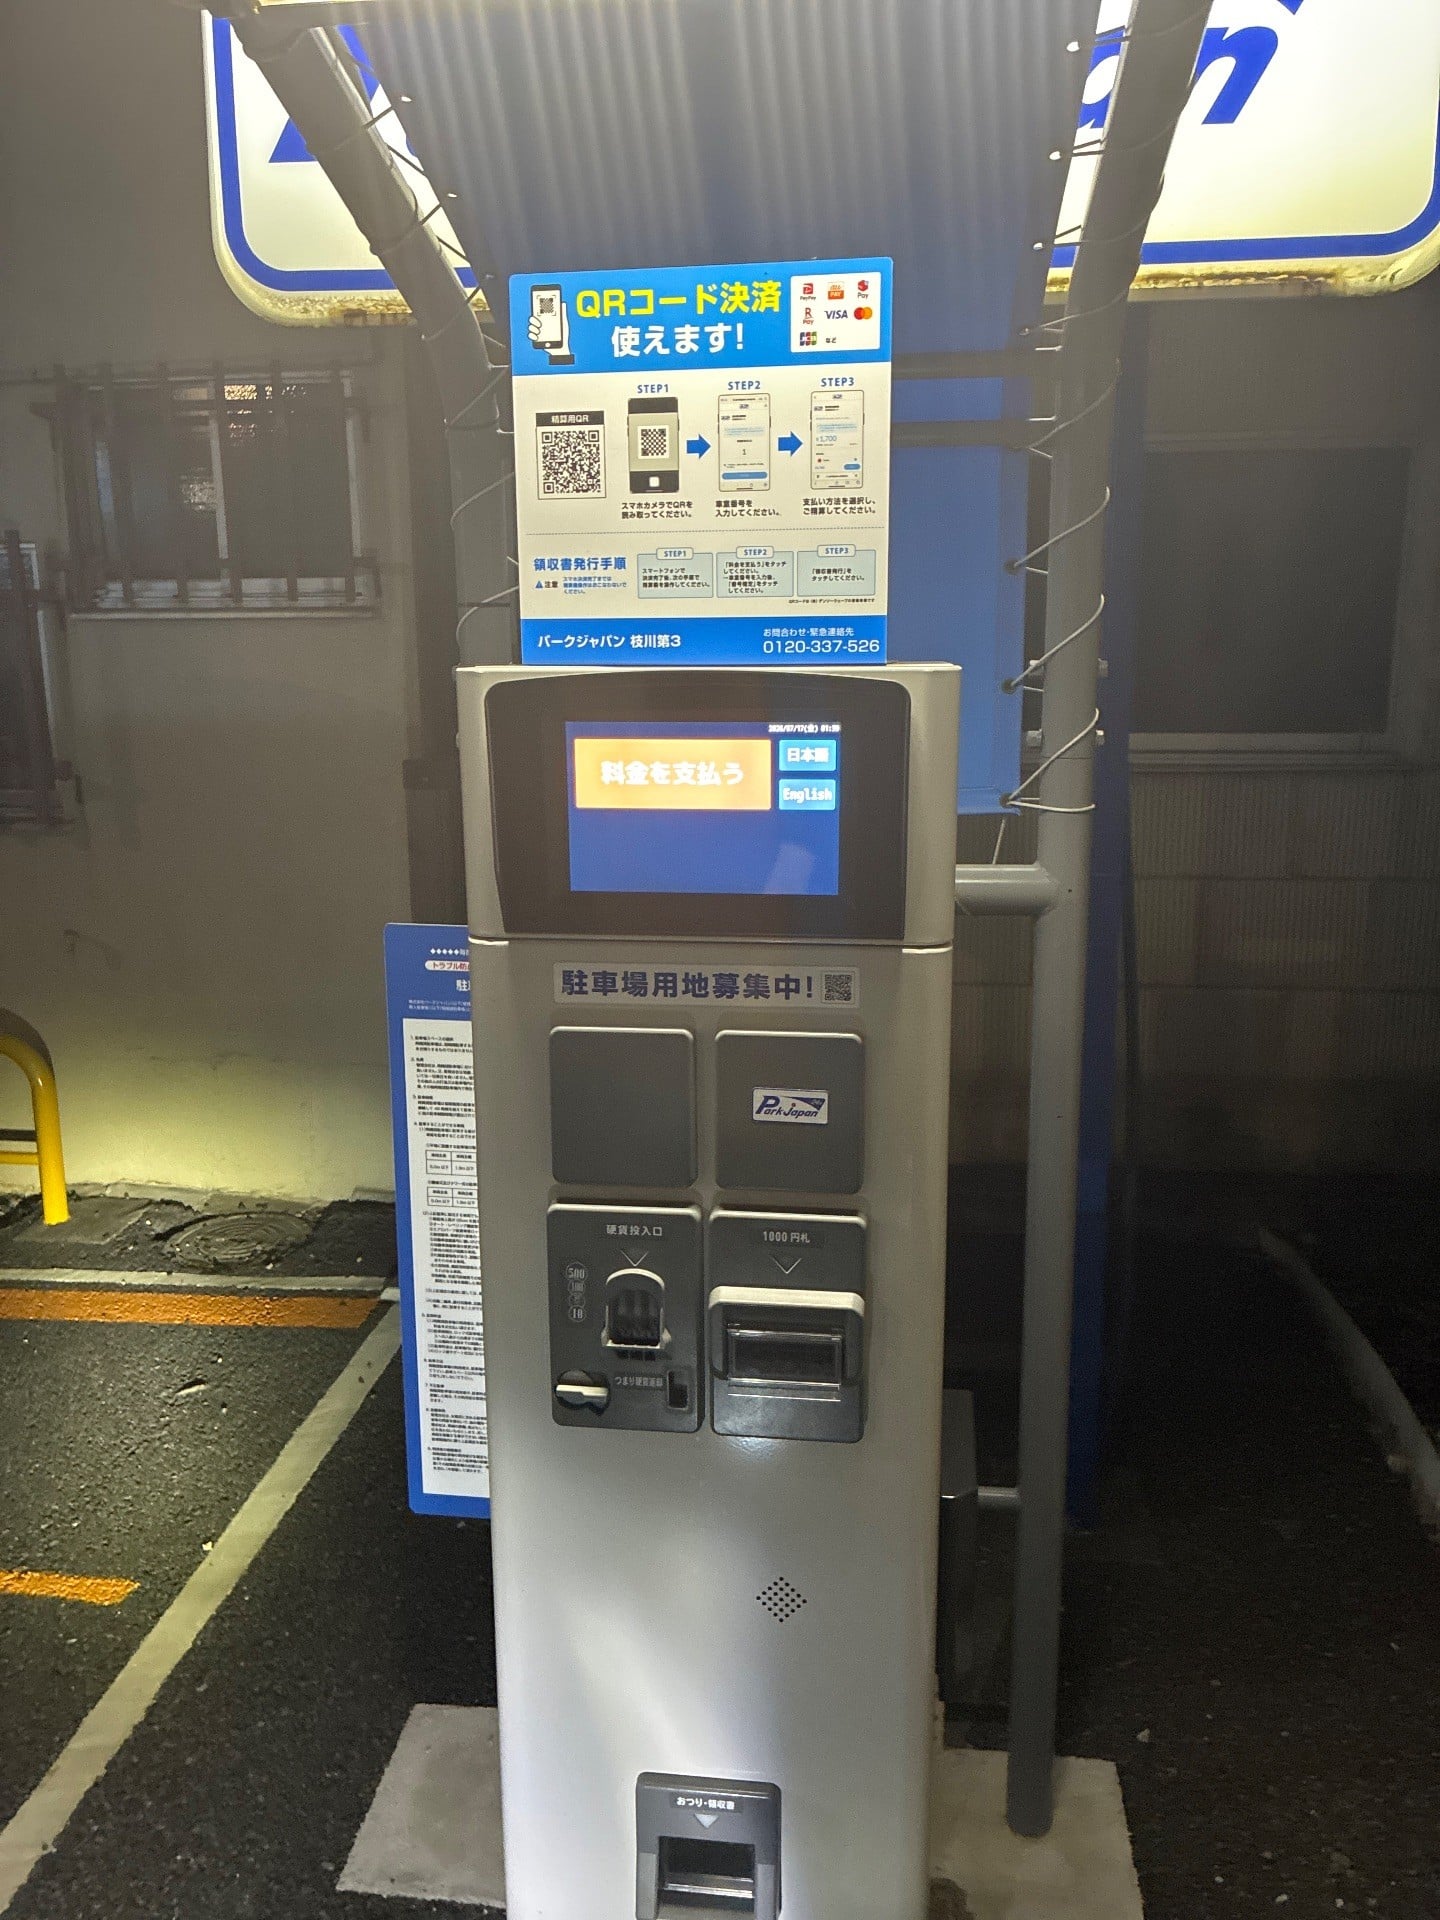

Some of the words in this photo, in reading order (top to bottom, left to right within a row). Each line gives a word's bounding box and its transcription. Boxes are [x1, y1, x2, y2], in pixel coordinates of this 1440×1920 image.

[576, 280, 782, 318] QRコード決済
[824, 310, 848, 319] VISA
[611, 323, 744, 357] 使えます!
[637, 384, 669, 393] STEP1
[728, 381, 761, 390] STEP2
[821, 377, 855, 387] STEP3
[621, 501, 693, 510] スマホカメラでQRを
[802, 497, 876, 506] 支払い方法を選択し、
[621, 510, 692, 519] 読み取ってください。
[715, 508, 780, 517] 入力してください。
[825, 547, 849, 555] STEP3
[533, 557, 627, 571] 領収書発行手順
[538, 634, 626, 648] パークジャパン
[630, 633, 682, 648] 枝川第3
[763, 639, 880, 654] 0120-337-526
[787, 748, 829, 763] 日本語
[601, 760, 744, 785] 料金を支払う
[782, 787, 832, 803] English
[561, 970, 813, 1000] 駐車場用地募集中!
[606, 1224, 663, 1237] 硬貨投入口
[763, 1231, 788, 1242] 1000
[790, 1232, 810, 1243] 円札
[676, 1796, 735, 1810] おつり・領収書
